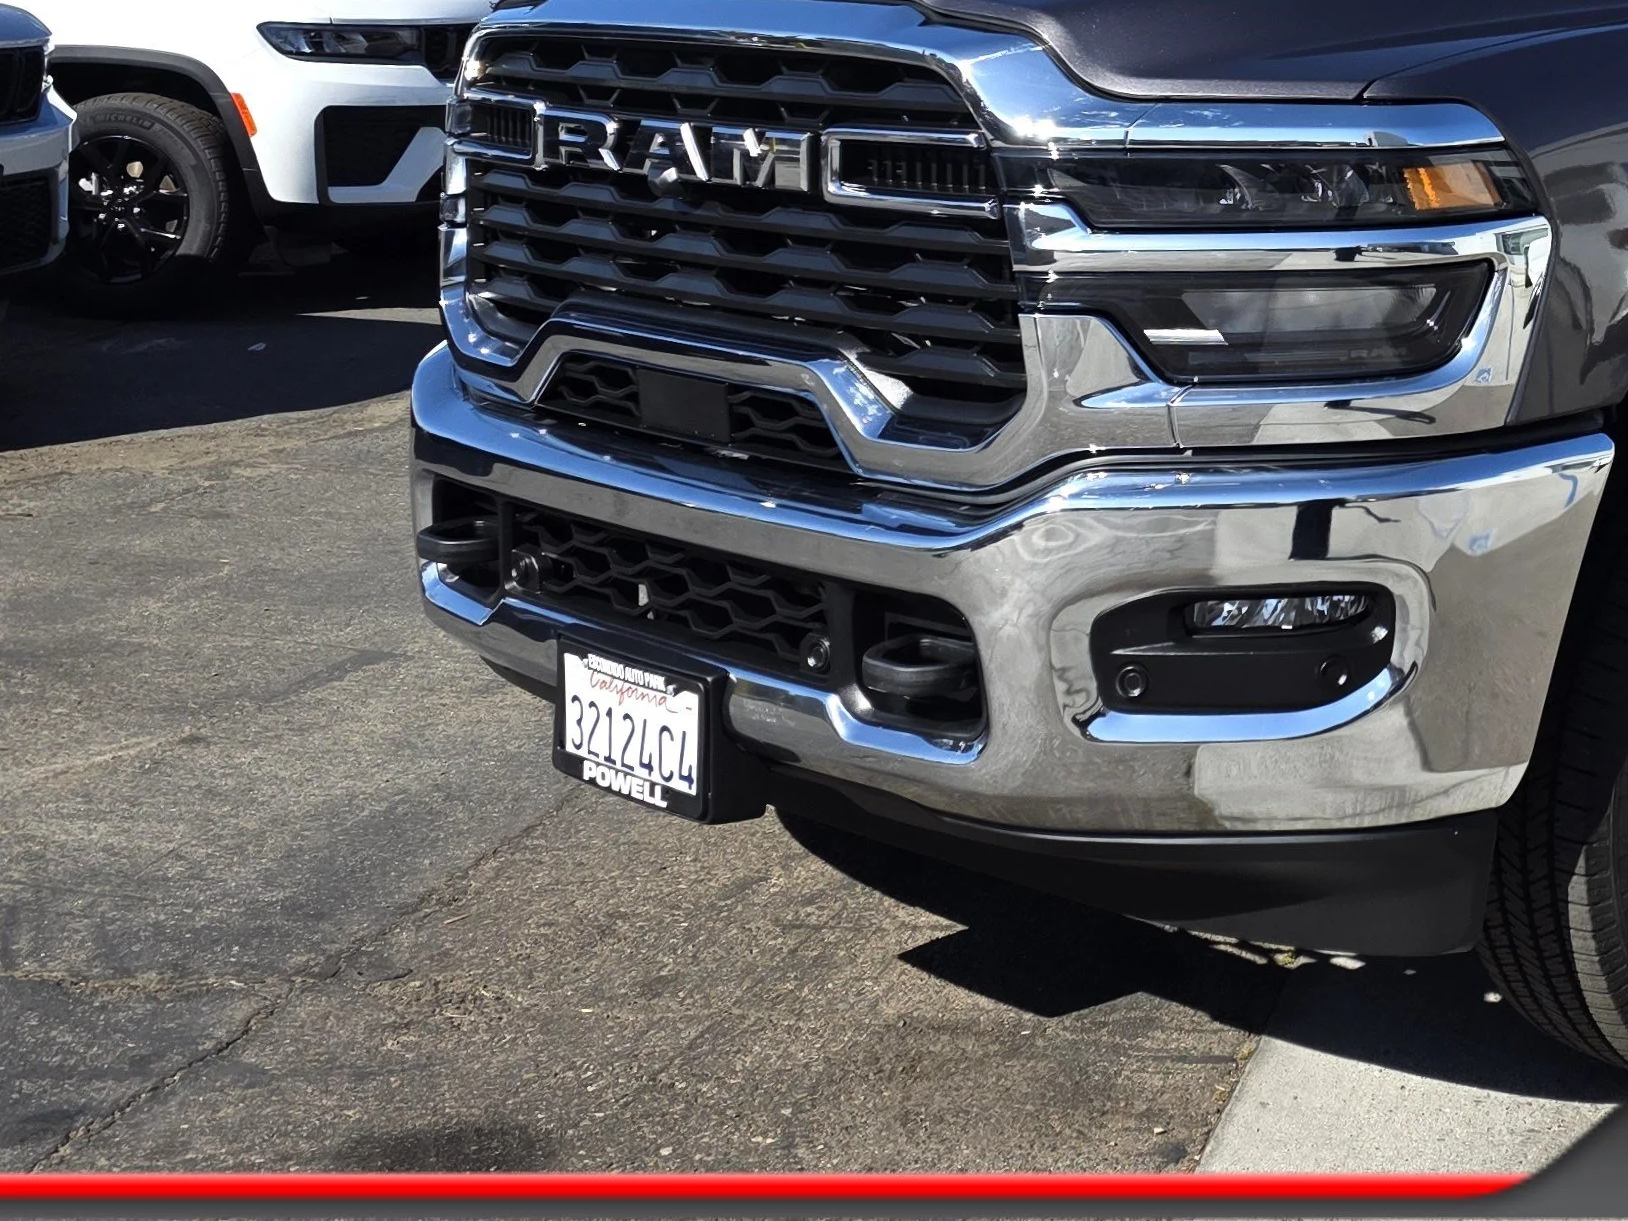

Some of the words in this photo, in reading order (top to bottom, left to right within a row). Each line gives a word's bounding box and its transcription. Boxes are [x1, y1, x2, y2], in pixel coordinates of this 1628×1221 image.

[541, 103, 815, 192] RAM
[590, 671, 679, 713] California
[625, 666, 645, 686] AUTO
[644, 671, 667, 692] PARK
[571, 694, 695, 791] 32124C4
[583, 760, 668, 808] POWELL
